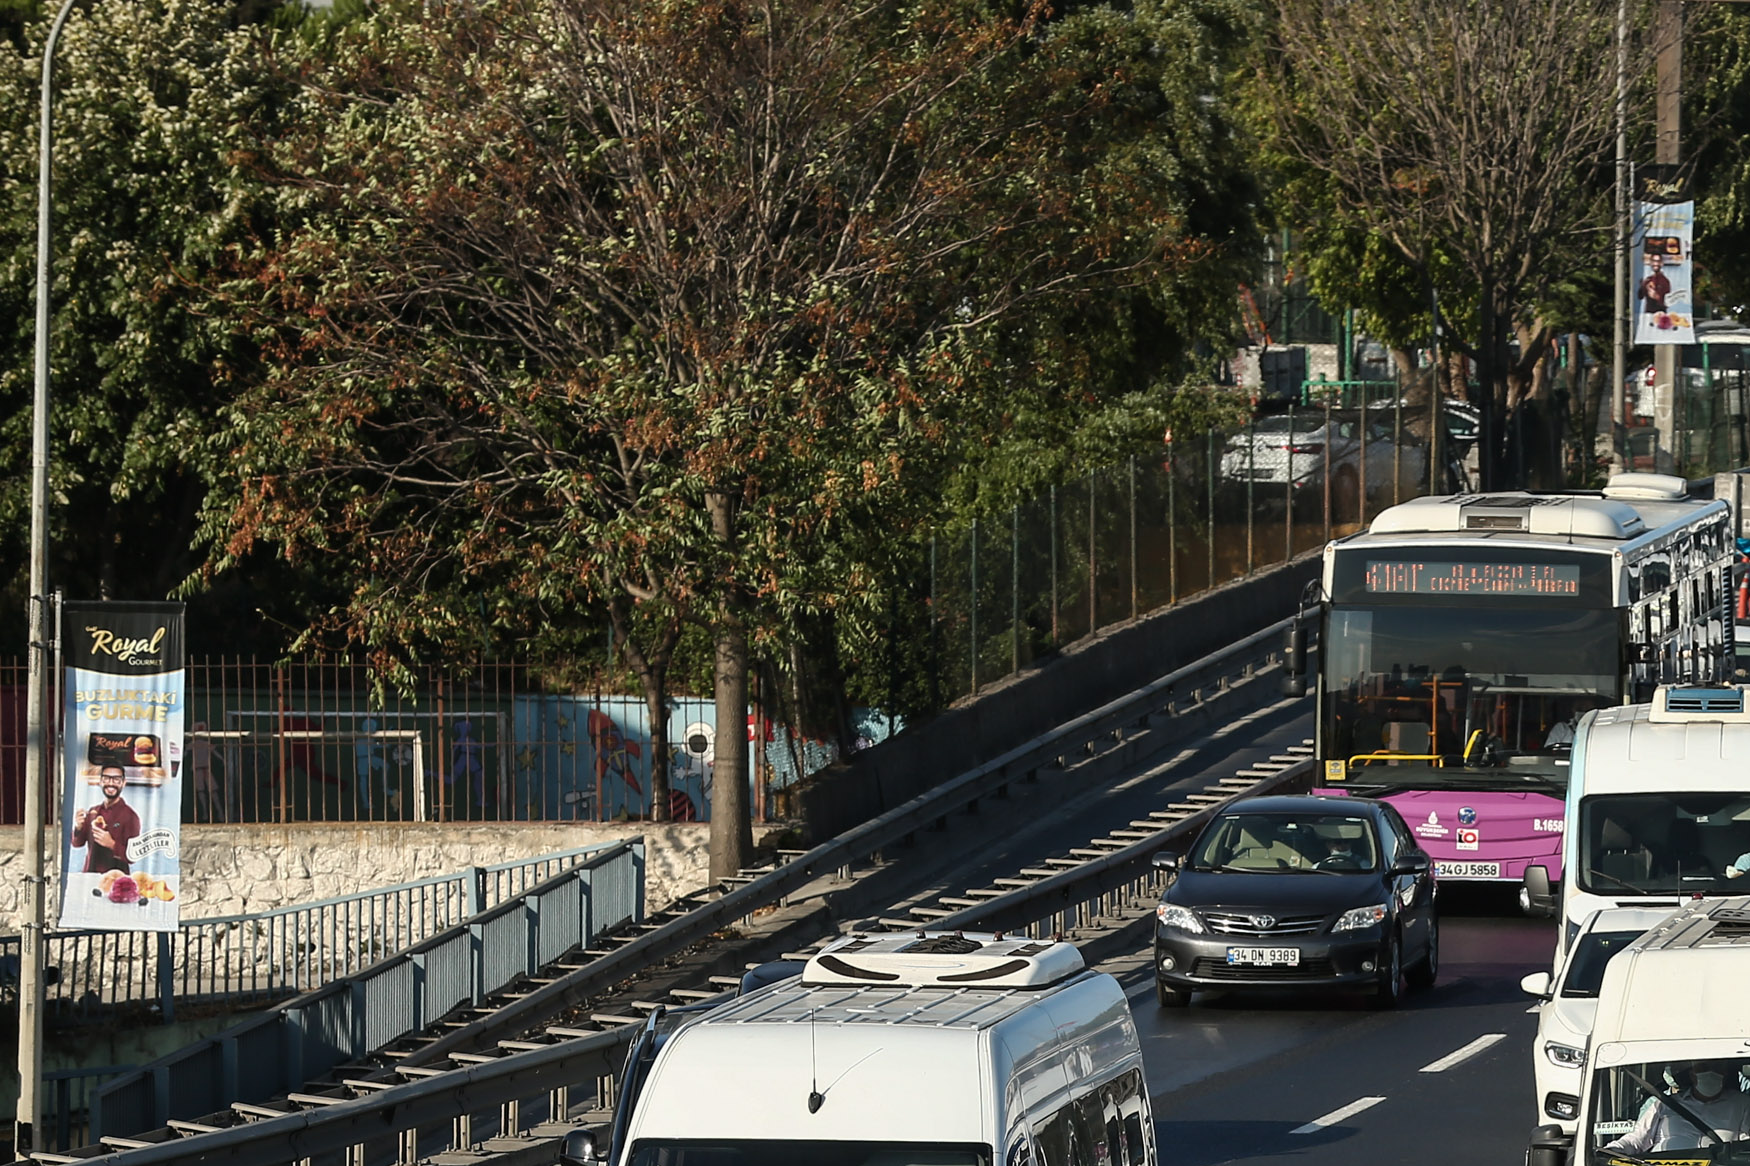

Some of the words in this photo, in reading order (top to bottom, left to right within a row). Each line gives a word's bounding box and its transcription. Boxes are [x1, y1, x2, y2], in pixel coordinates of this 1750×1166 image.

[91, 627, 166, 661] Royal
[85, 703, 169, 722] GURME
[95, 736, 132, 750] Royal
[1440, 864, 1453, 875] 34
[1454, 865, 1469, 875] GJ
[1470, 865, 1497, 876] 5858
[1235, 950, 1247, 961] 34
[1270, 950, 1297, 961] 9389
